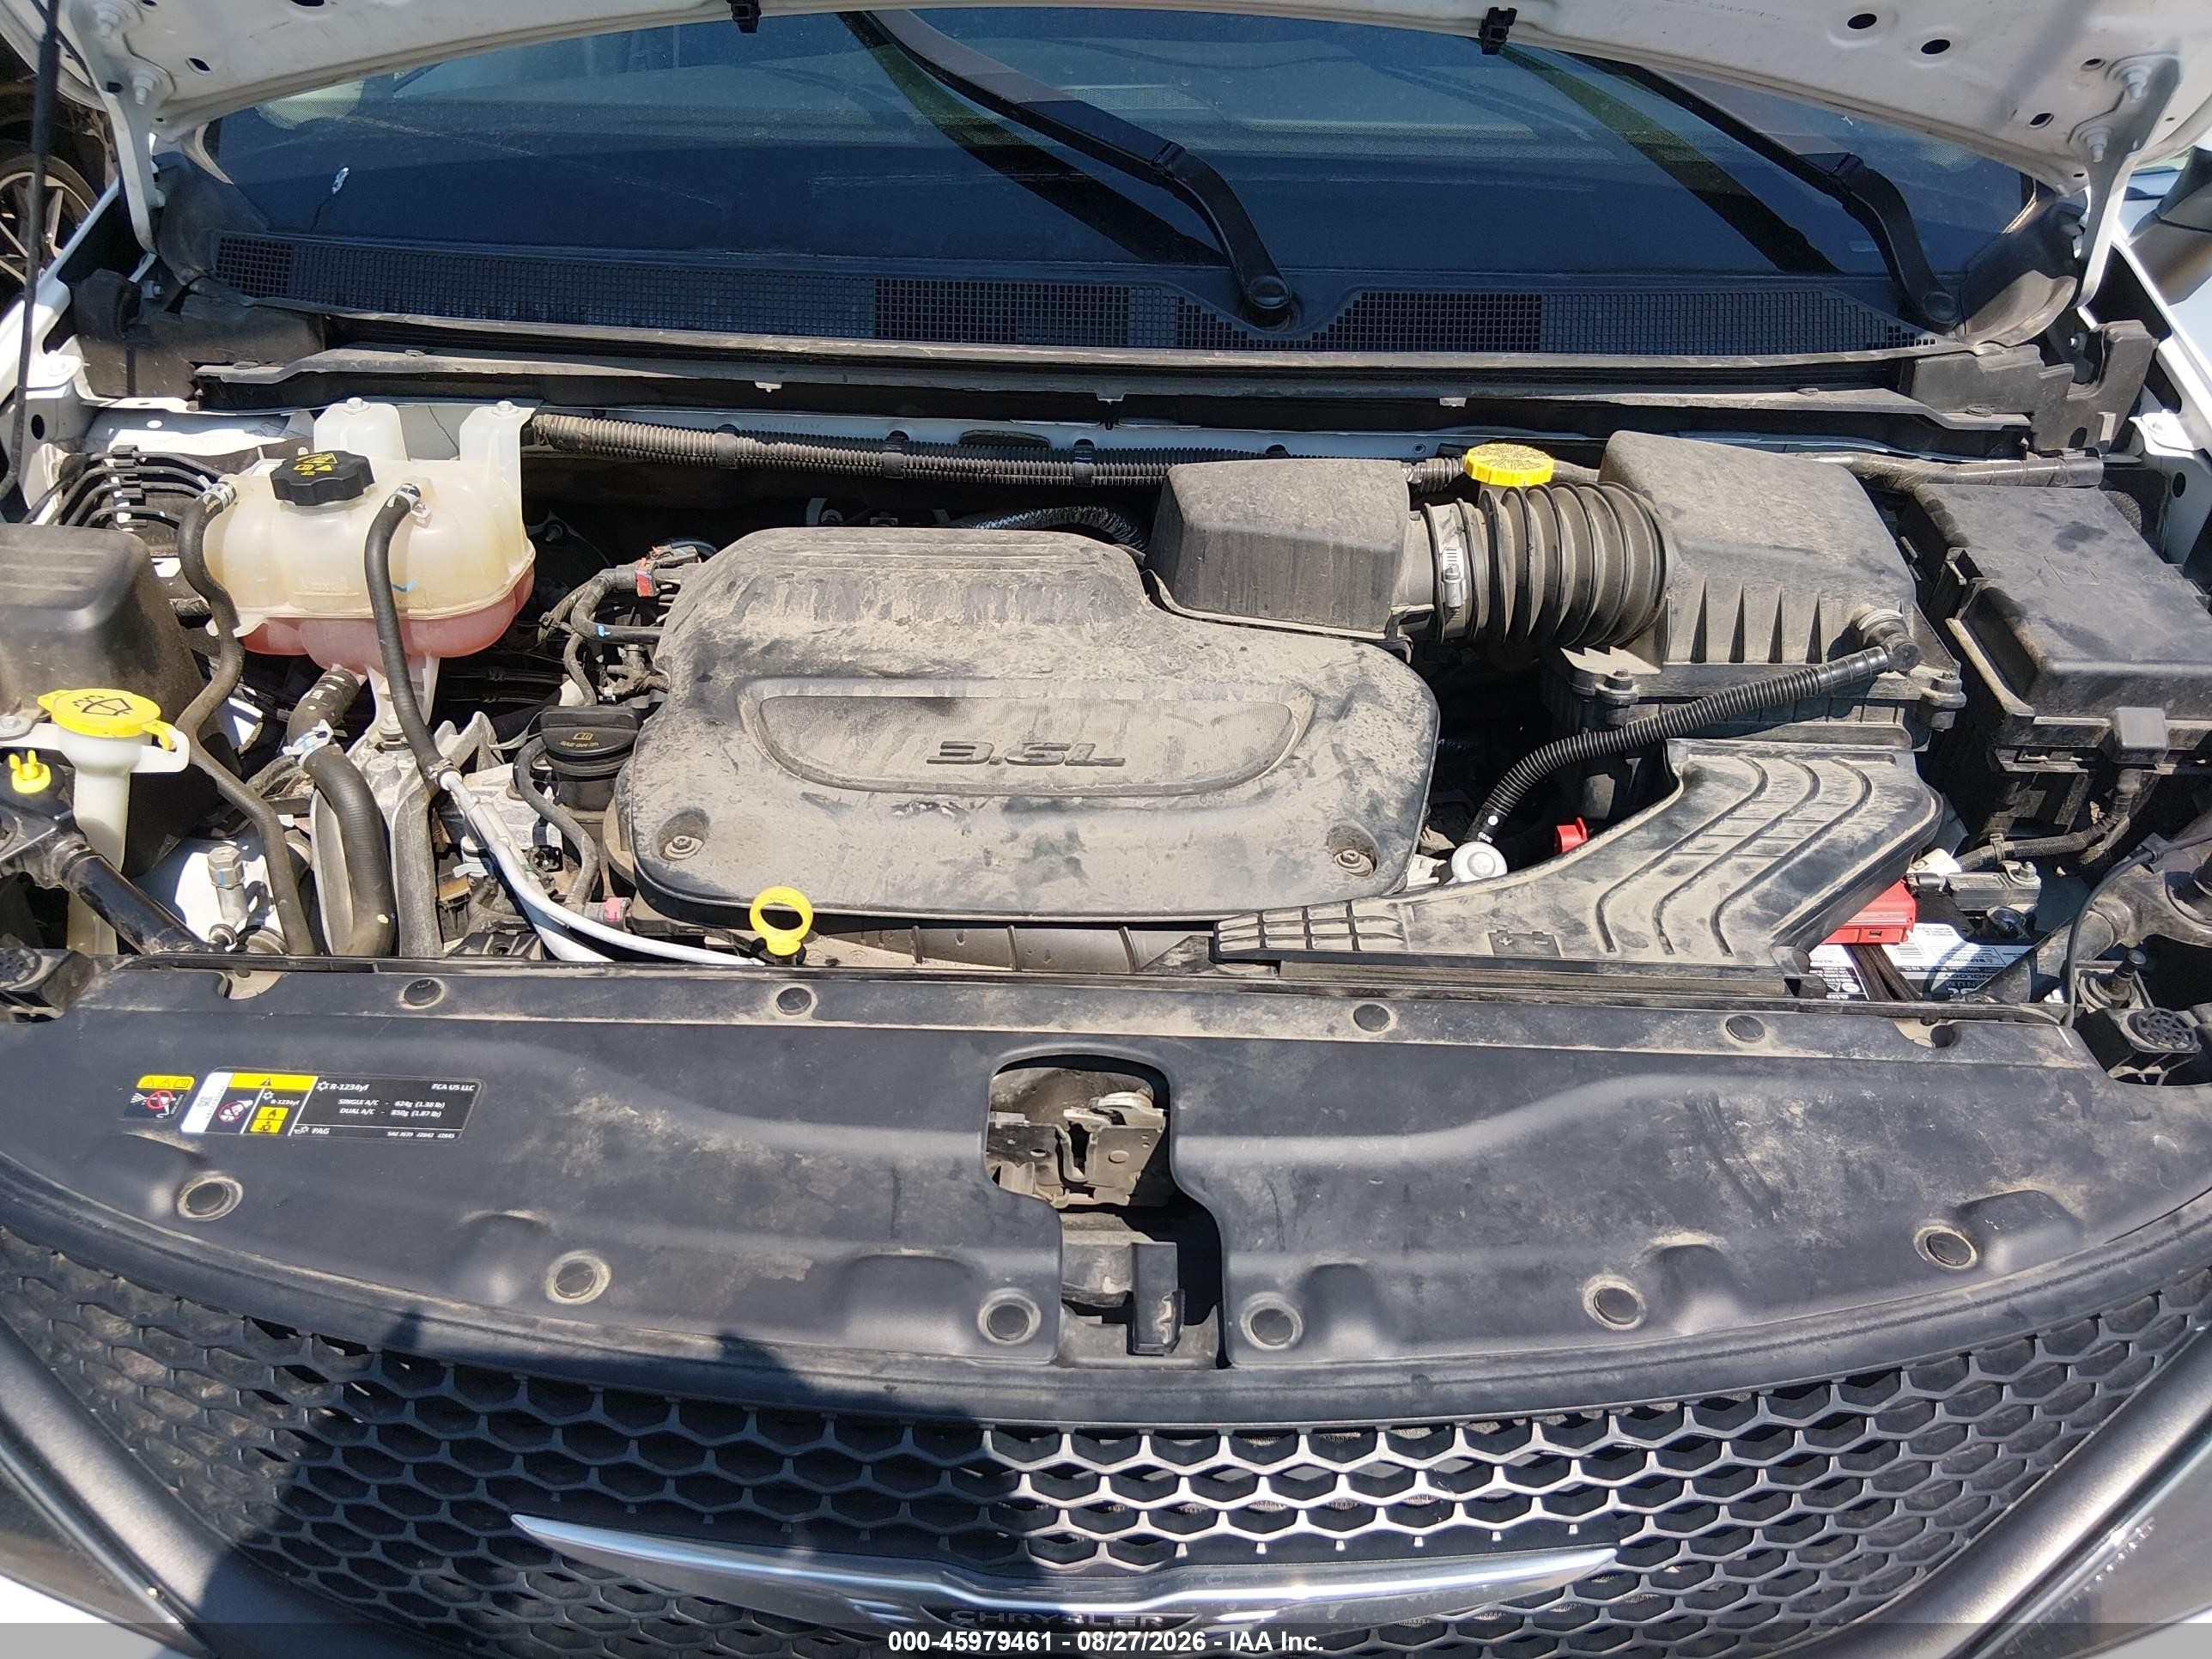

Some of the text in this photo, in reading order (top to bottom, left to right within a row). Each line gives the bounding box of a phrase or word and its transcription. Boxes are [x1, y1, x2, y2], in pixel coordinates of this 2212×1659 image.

[926, 740, 1127, 767] 3.6L
[329, 1083, 369, 1092] R-1234yf
[949, 1610, 1164, 1628] CHRYSLER
